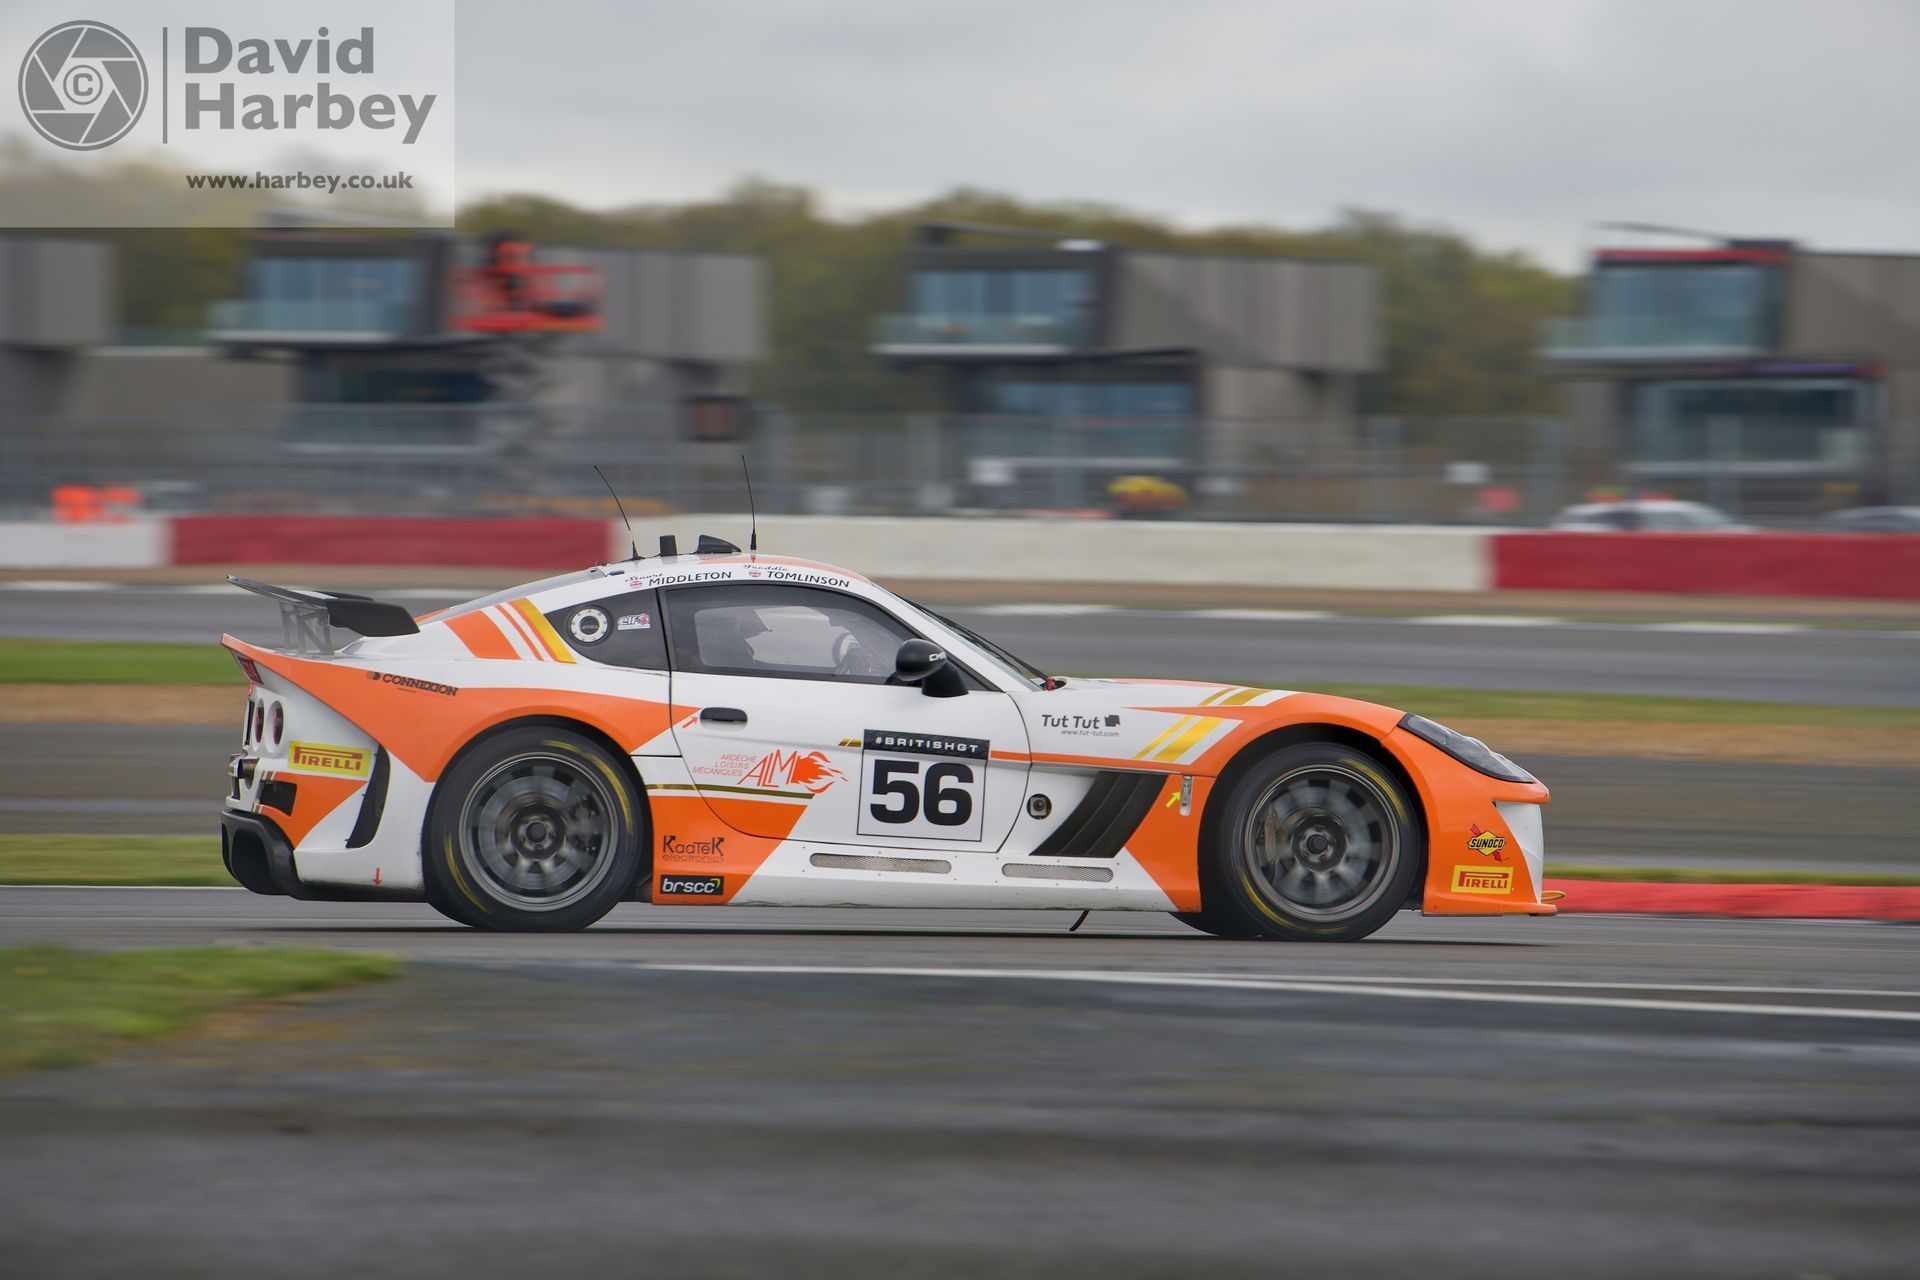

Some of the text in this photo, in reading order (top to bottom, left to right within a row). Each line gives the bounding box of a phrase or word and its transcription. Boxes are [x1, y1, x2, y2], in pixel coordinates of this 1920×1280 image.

[648, 571, 732, 586] MIDDLETON
[767, 570, 850, 588] TOMLINSON
[382, 673, 459, 697] CONNEXION
[1041, 714, 1100, 730] Tut Tut
[875, 736, 979, 753] #BRITISHGT
[293, 746, 363, 771] PIRELLI
[714, 761, 750, 770] LOISIRS
[737, 748, 798, 788] ALM
[870, 758, 974, 827] 56
[1469, 838, 1504, 848] SUNOCO
[662, 878, 715, 893] brscc
[1458, 871, 1509, 889] PIRELLI
